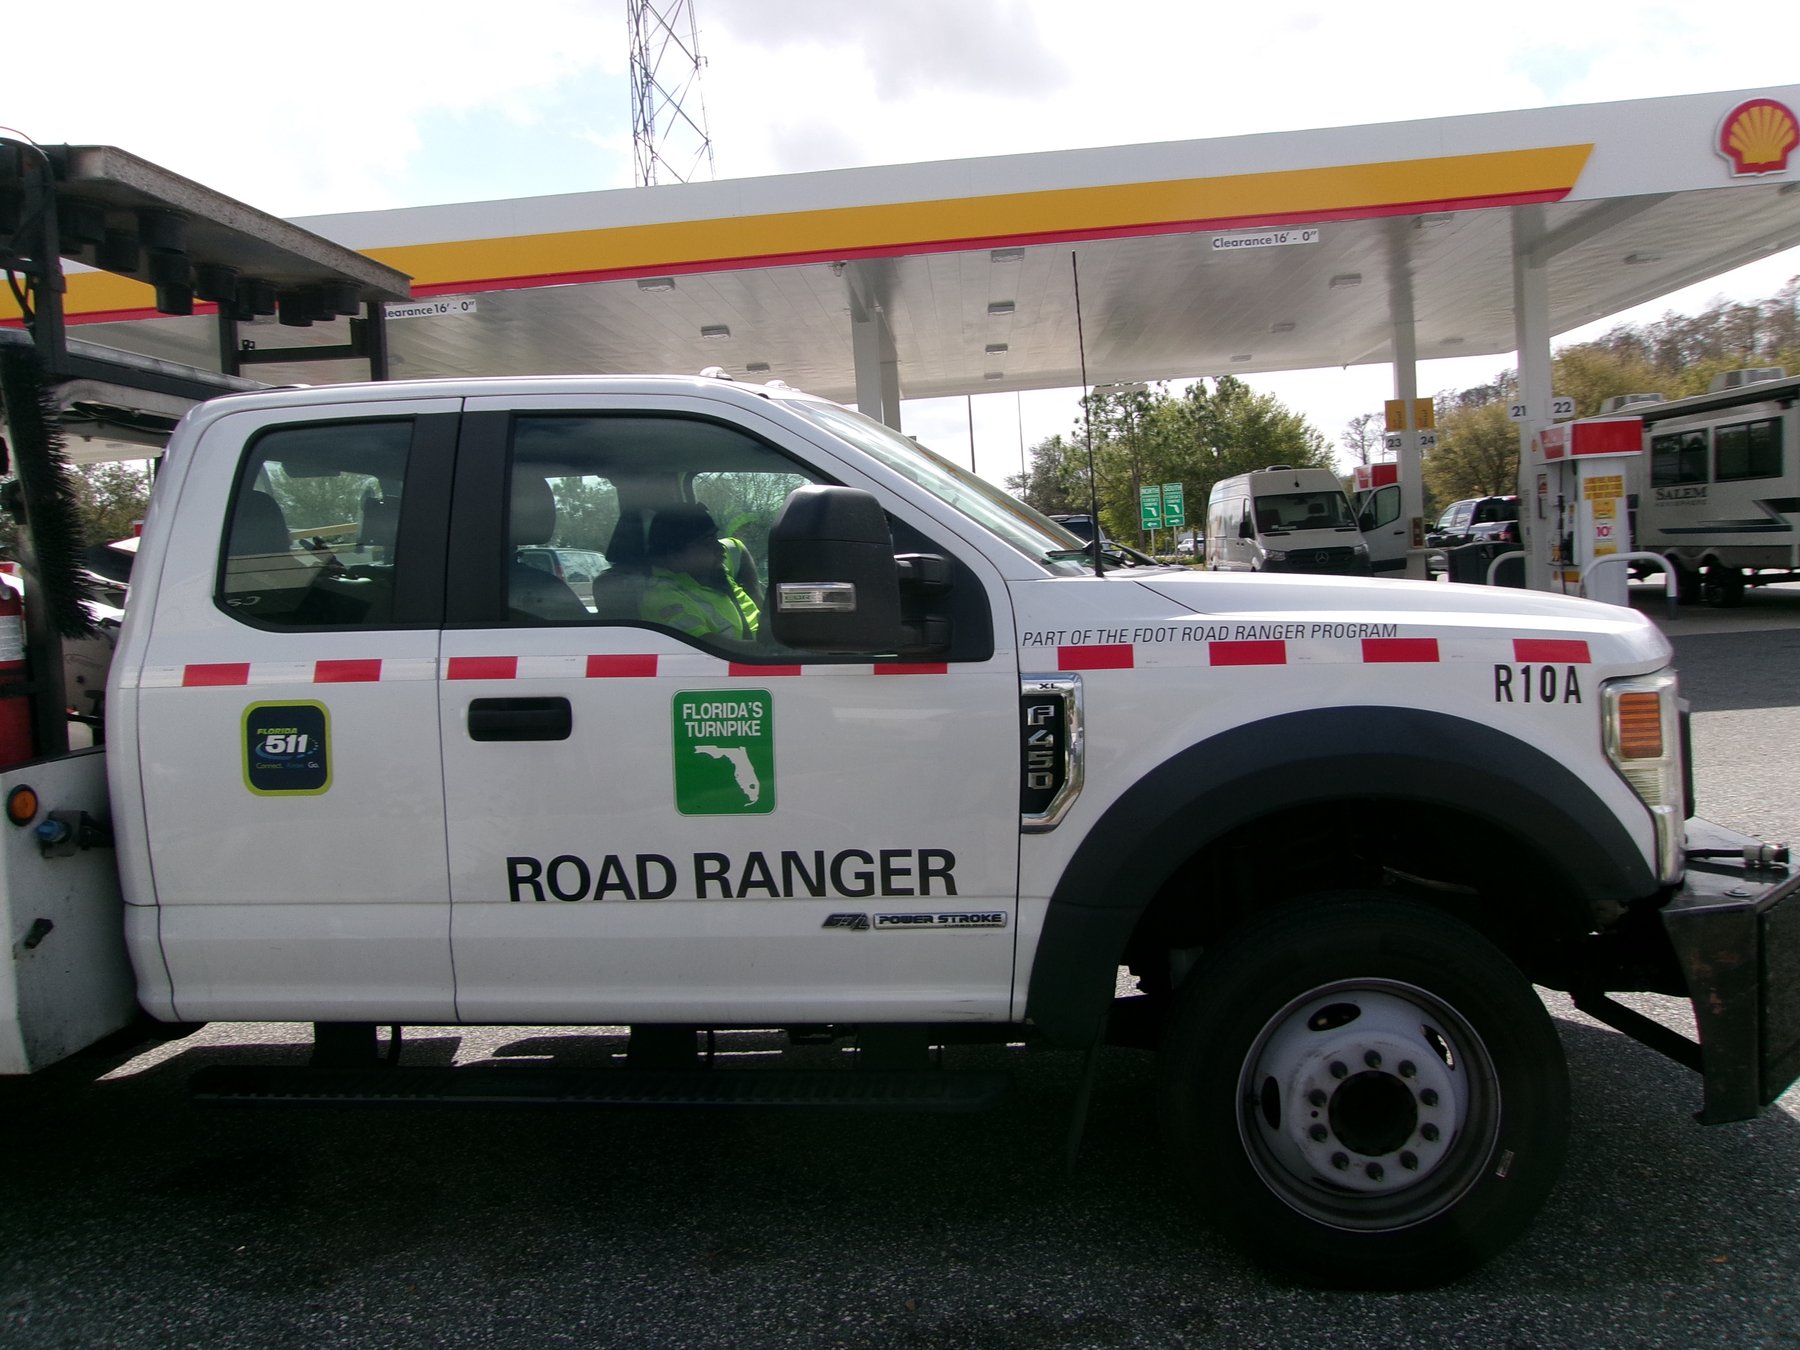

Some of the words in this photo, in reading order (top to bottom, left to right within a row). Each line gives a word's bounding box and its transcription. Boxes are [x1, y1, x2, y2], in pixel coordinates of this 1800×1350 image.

[1213, 237, 1272, 248] Clearance
[1512, 405, 1527, 416] 21
[1553, 402, 1571, 413] 22
[1388, 438, 1402, 447] 23
[1421, 436, 1434, 445] 24
[1656, 487, 1708, 500] SALEM
[1023, 631, 1066, 646] PART
[1071, 630, 1092, 644] OF
[1098, 629, 1129, 644] THE
[1133, 628, 1178, 643] FDOT
[1182, 626, 1229, 642] ROAD
[1235, 624, 1306, 640] RANGER
[1311, 623, 1397, 639] PROGRAM
[1494, 664, 1582, 703] R10A
[683, 702, 763, 719] FLORIDA'S
[685, 720, 761, 737] TURNPIKE
[265, 735, 308, 753] 511
[506, 853, 678, 902] ROAD
[693, 848, 958, 899] RANGER
[879, 915, 934, 924] POWER
[938, 914, 1002, 923] STROKE
